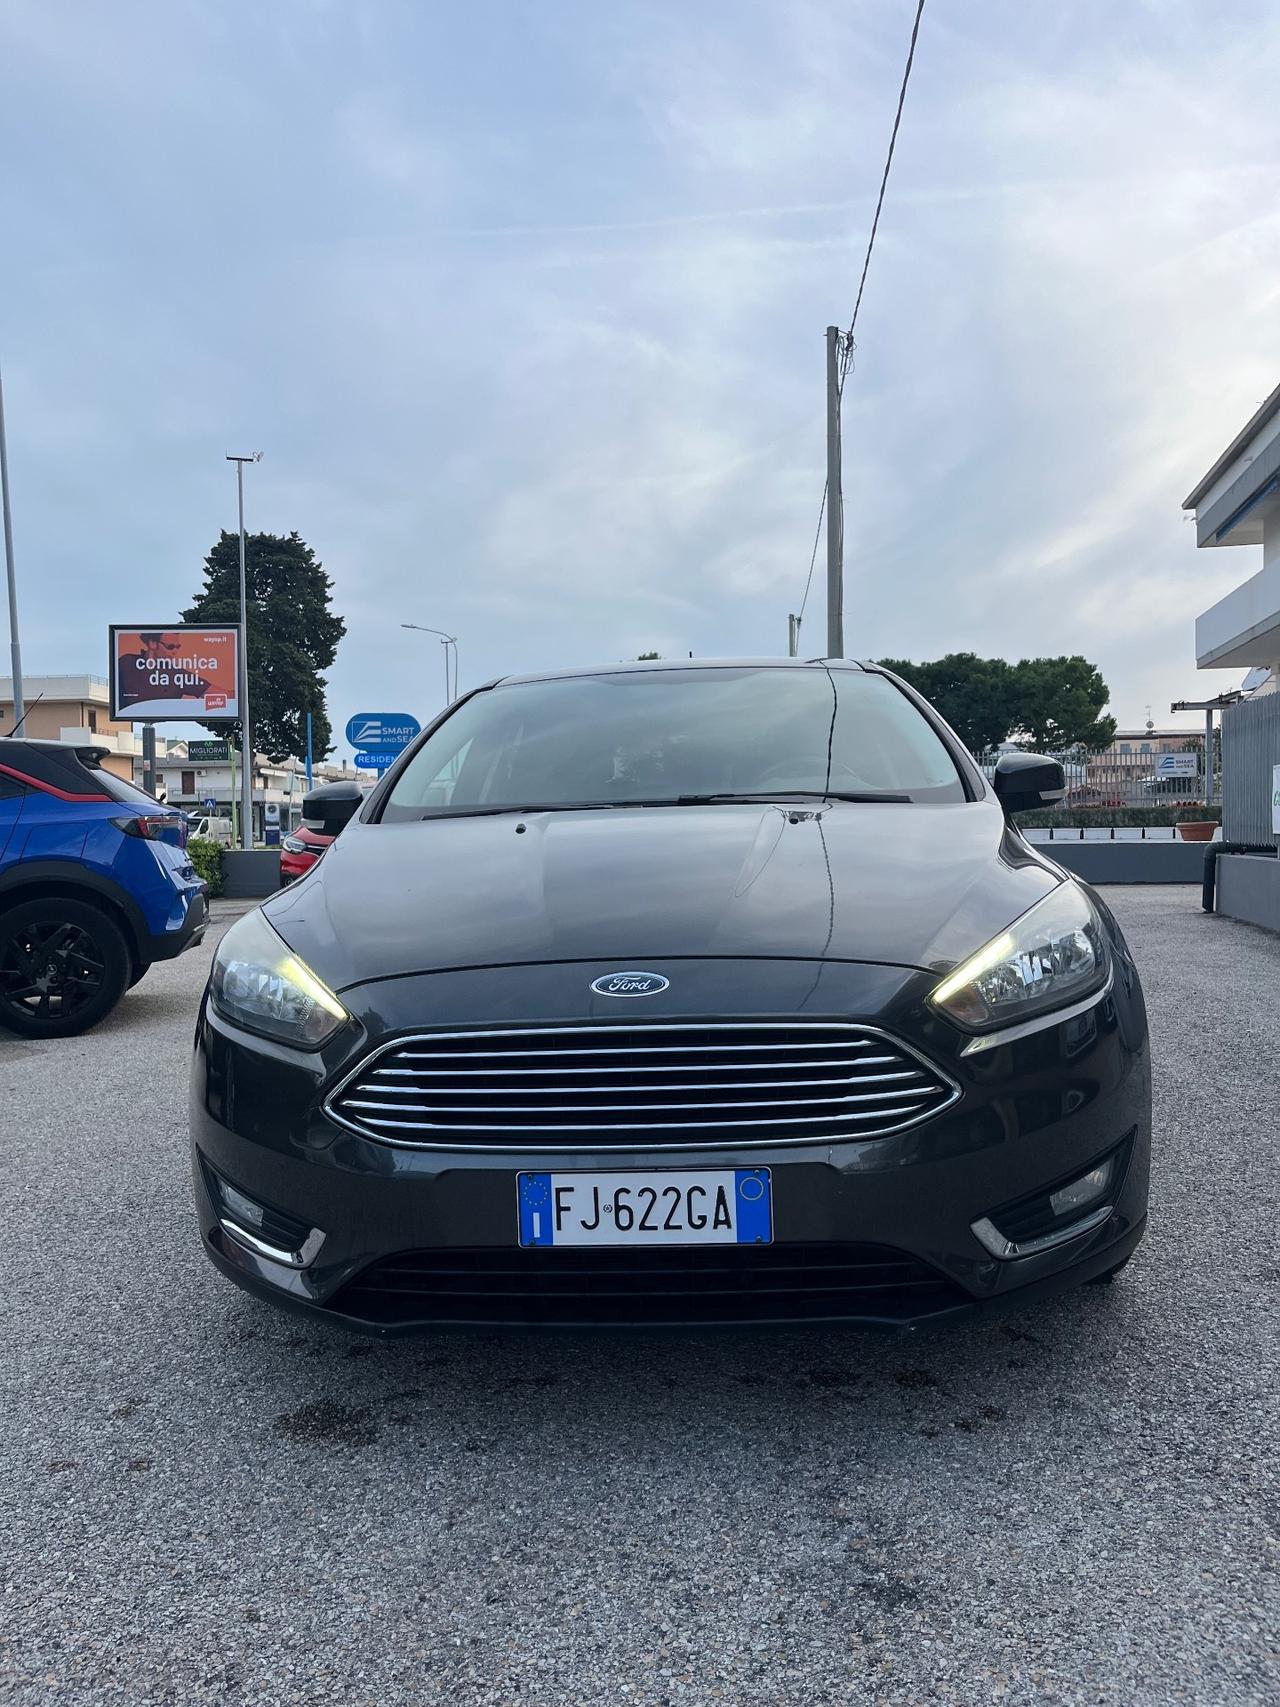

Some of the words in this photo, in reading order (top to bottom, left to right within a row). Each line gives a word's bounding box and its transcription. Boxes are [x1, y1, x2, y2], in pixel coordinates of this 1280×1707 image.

[136, 654, 218, 669] comunica
[149, 670, 169, 685] da
[174, 670, 204, 688] qui.
[382, 727, 415, 735] SMART
[608, 976, 652, 991] Ford
